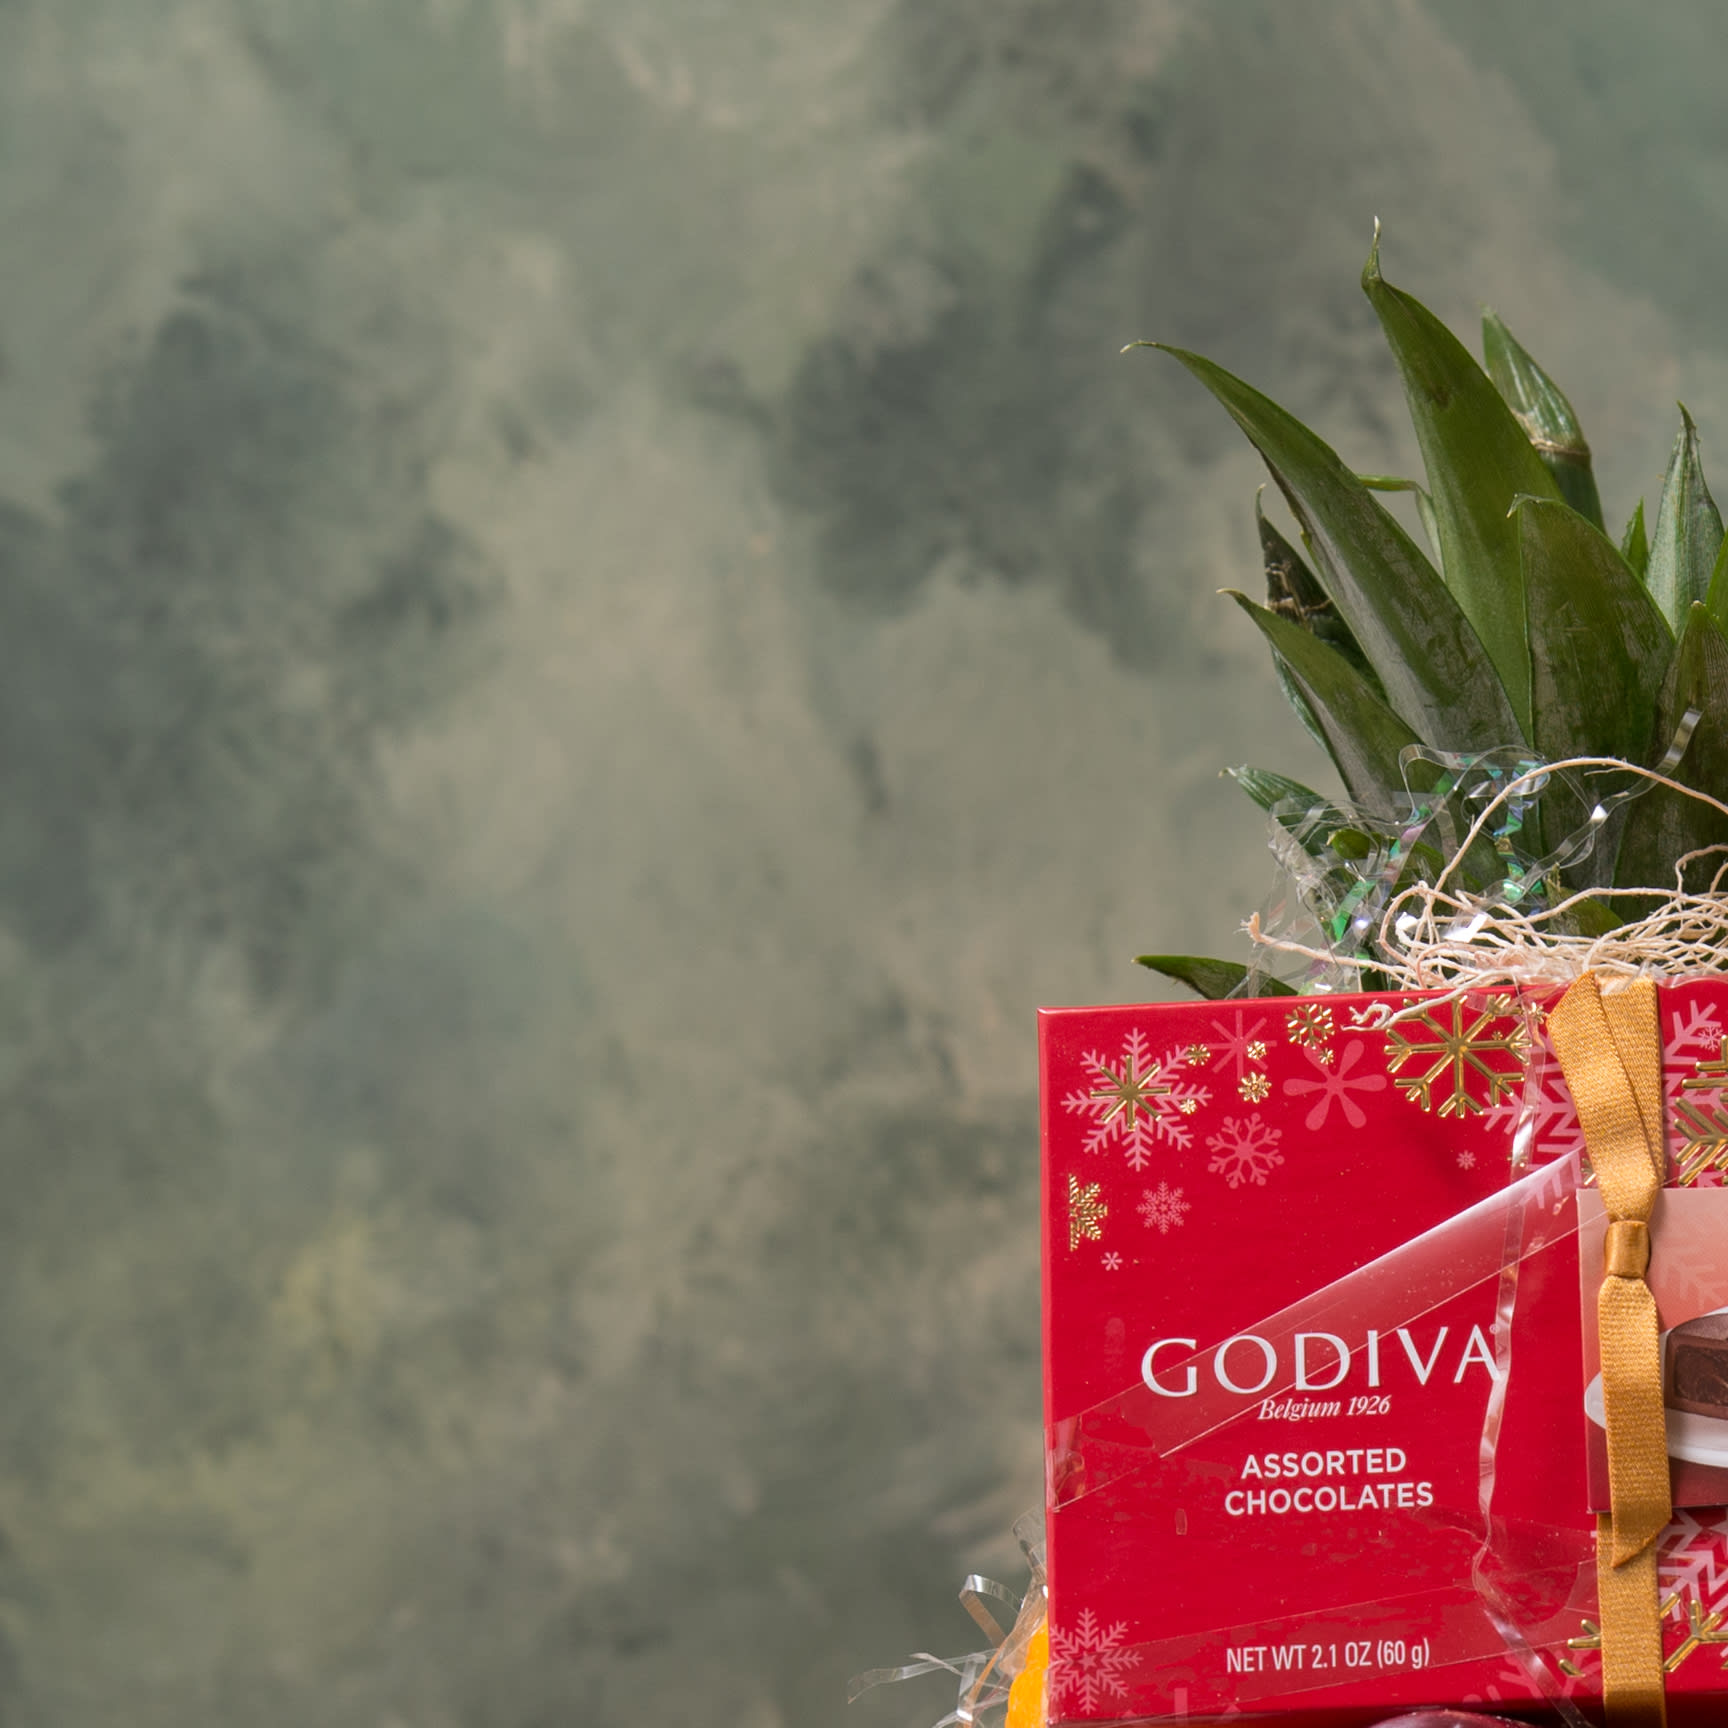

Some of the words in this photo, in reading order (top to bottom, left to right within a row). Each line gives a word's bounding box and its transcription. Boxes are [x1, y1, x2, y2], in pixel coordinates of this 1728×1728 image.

[1141, 1324, 1501, 1397] GODIVA
[1257, 1398, 1340, 1422] Belgium
[1348, 1395, 1391, 1416] 1926
[1241, 1448, 1407, 1479] ASSORTED
[1224, 1482, 1433, 1516] CHOCOLATES
[1226, 1646, 1267, 1673] NET
[1272, 1644, 1306, 1670] WT
[1312, 1643, 1336, 1669] 2.1
[1345, 1641, 1372, 1667] OZ
[1377, 1639, 1405, 1669] (60
[1411, 1637, 1430, 1670] g)
